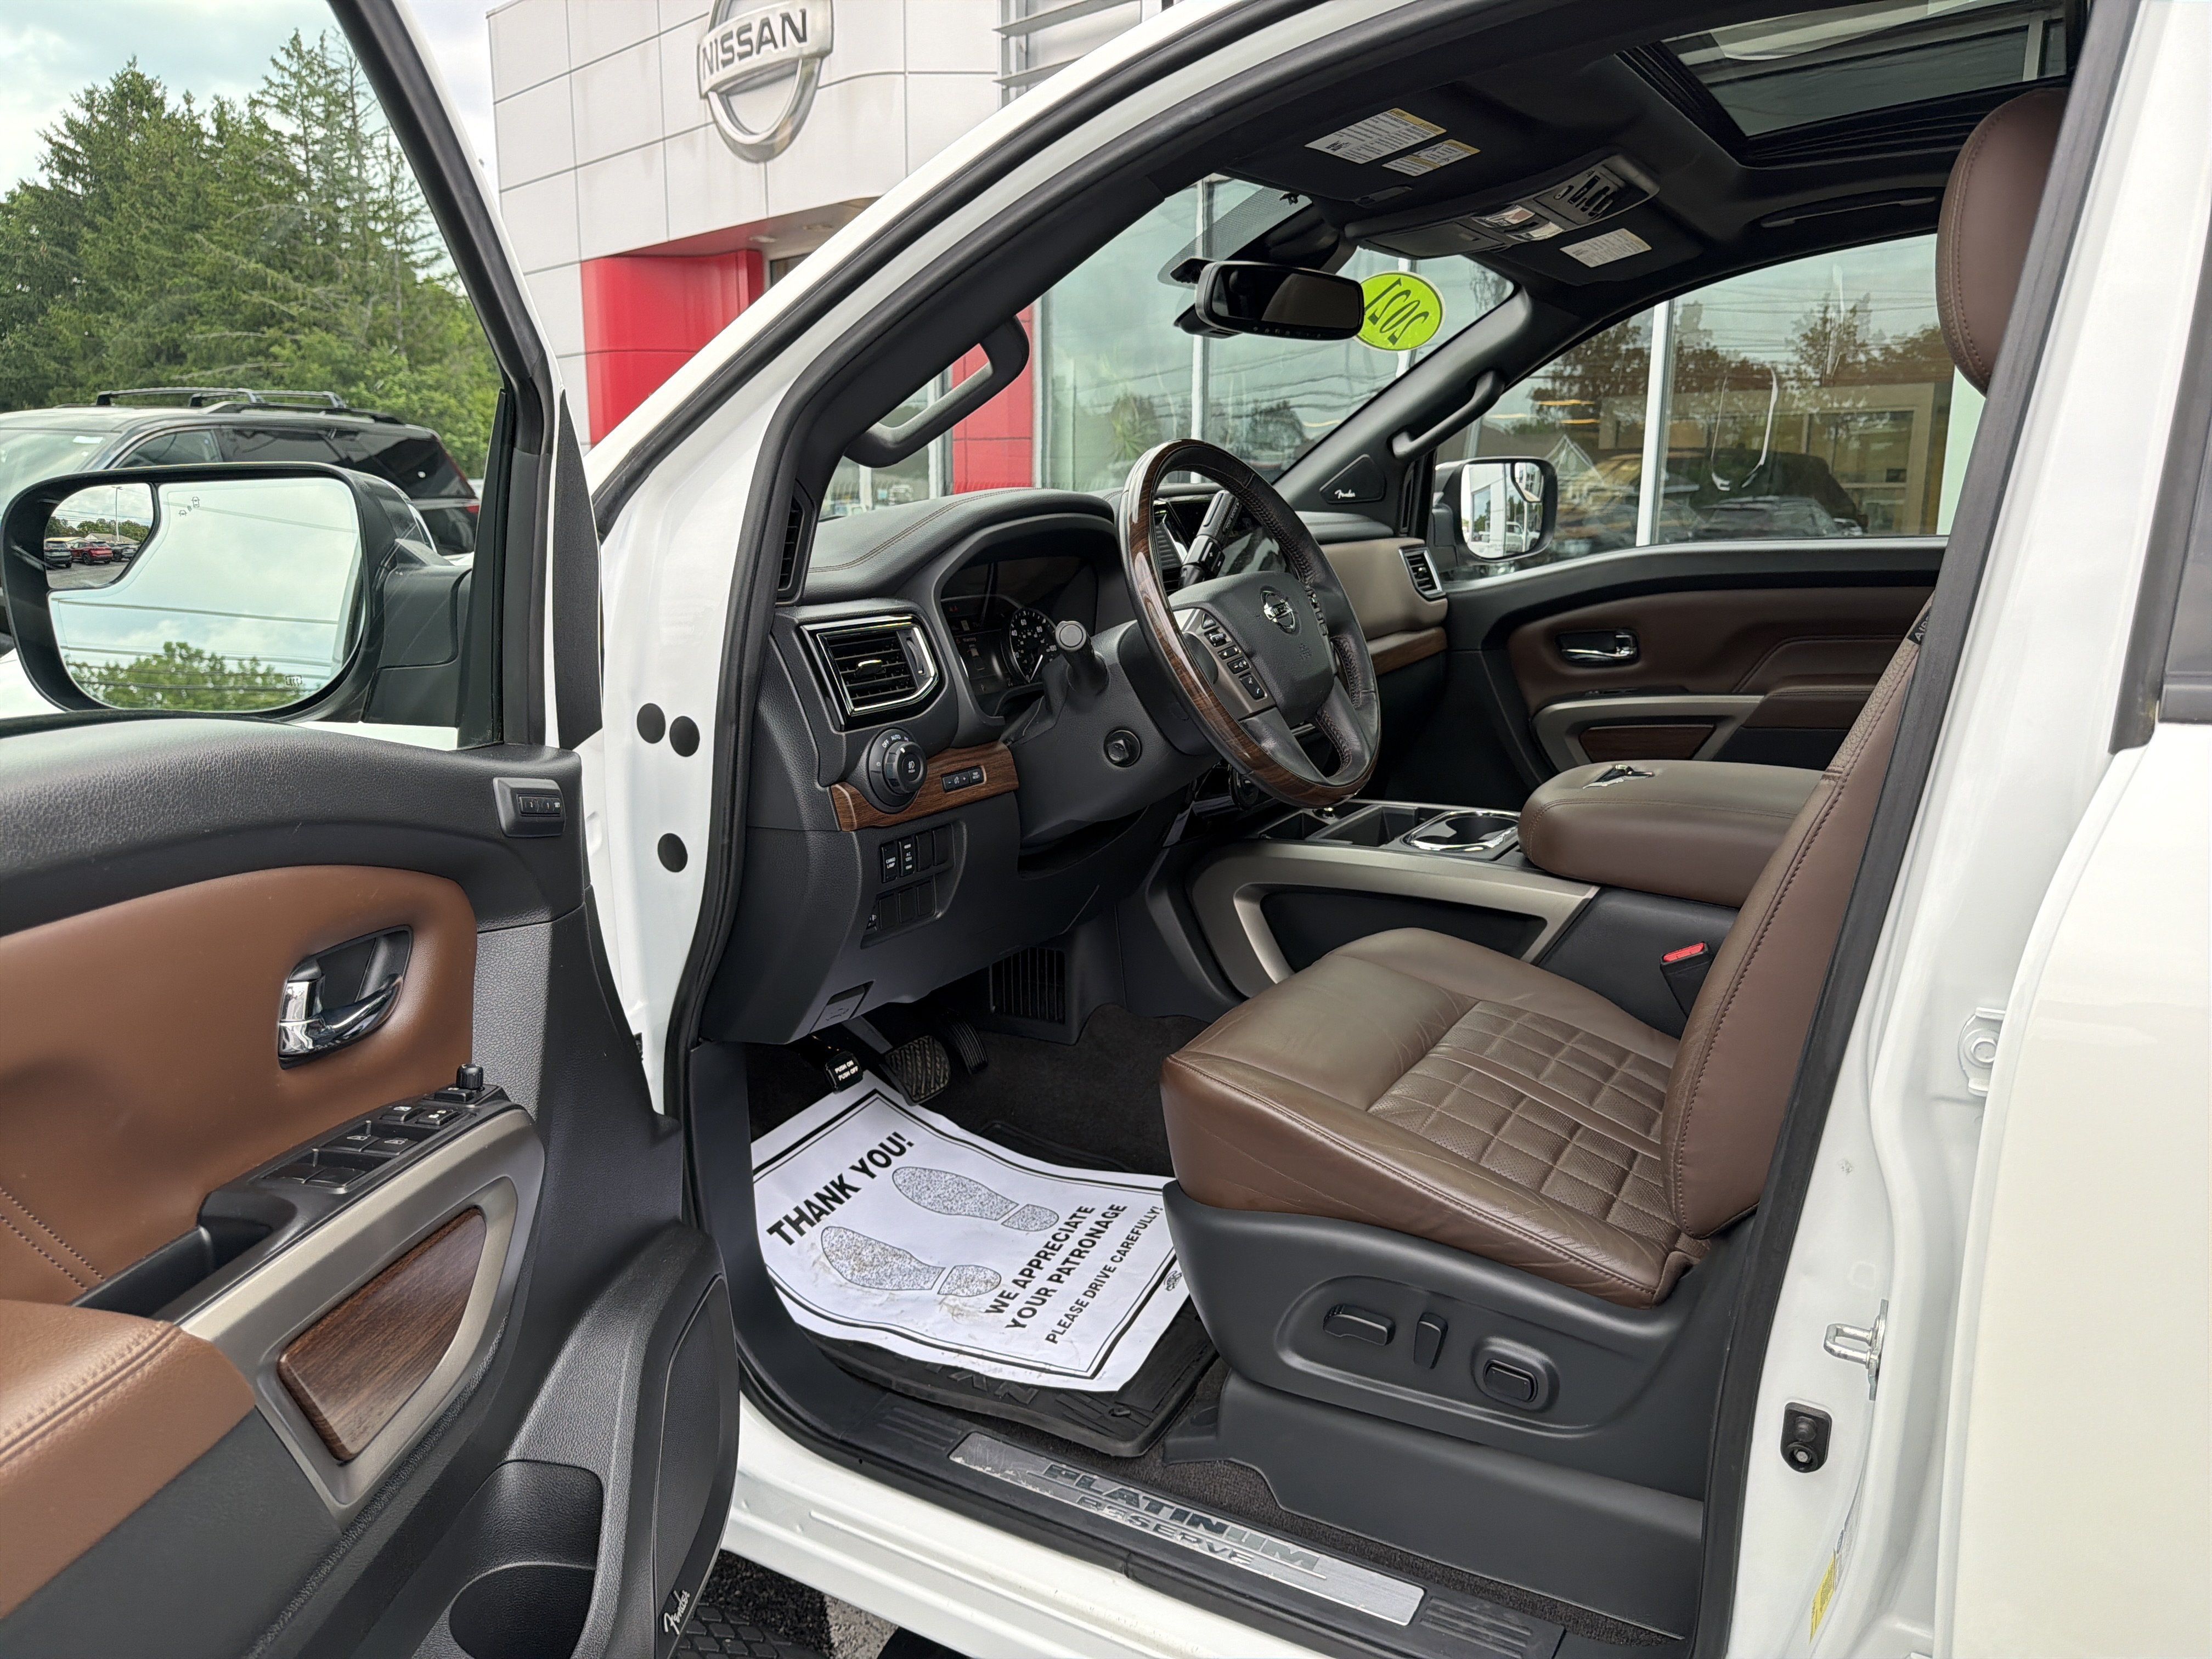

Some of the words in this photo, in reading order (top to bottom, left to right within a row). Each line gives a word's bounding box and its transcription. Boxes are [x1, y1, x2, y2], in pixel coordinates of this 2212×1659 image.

[703, 8, 807, 80] NISSAN
[766, 1173, 861, 1246] THANK
[849, 1131, 915, 1180] YOU!
[984, 1290, 1020, 1313] WE
[1012, 1206, 1096, 1290] APPRECIATE
[1005, 1287, 1057, 1328] YOUR
[1046, 1204, 1128, 1284] PATRONAGE
[1045, 1298, 1090, 1344] PLEASE
[1082, 1265, 1117, 1299] DRIVE
[1110, 1206, 1164, 1263] CAREFULLY!
[1043, 1463, 1320, 1571] PLATINUM
[1076, 1496, 1255, 1565] RESERVE
[664, 1589, 690, 1635] Fender
